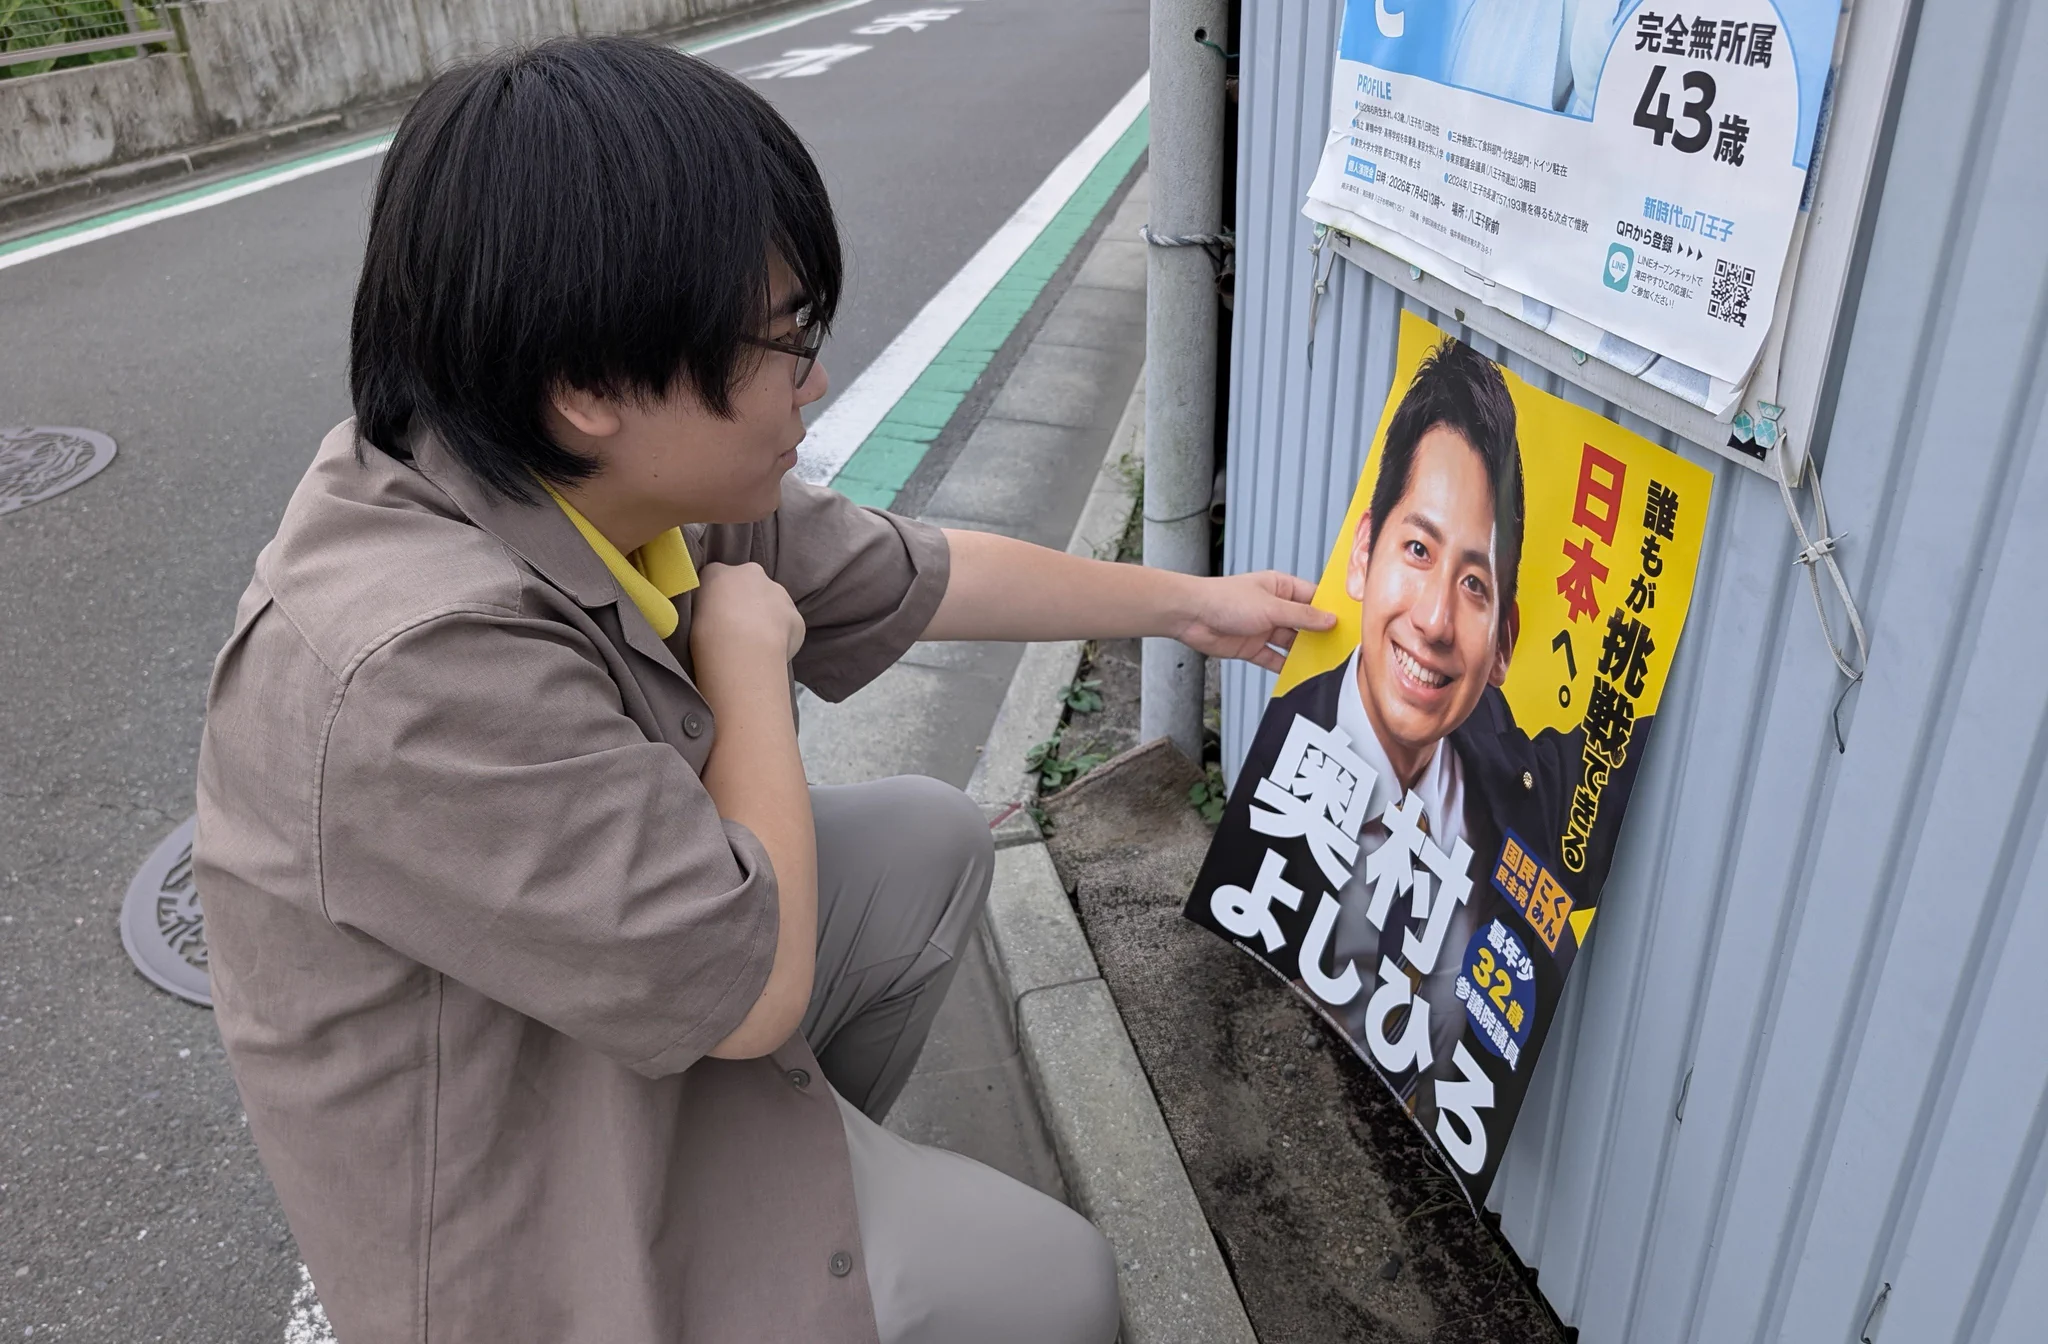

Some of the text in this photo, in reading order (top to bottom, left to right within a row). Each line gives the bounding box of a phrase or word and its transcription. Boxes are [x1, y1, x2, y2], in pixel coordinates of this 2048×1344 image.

[1634, 11, 1777, 69] 完全無所属
[1357, 74, 1392, 100] PROFILE
[1633, 65, 1750, 167] 43歳
[1616, 220, 1674, 253] QRから登録
[1642, 196, 1735, 243] 新時代の八王子
[1611, 259, 1626, 272] LINE
[1634, 269, 1694, 300] 滝田やすひこの応援に
[1637, 254, 1703, 287] LINEオープンチャットで
[1552, 442, 1627, 709] 日本へ。
[1249, 713, 1475, 975] 奥村
[1501, 837, 1539, 889] 国民
[1495, 864, 1529, 908] 民主党
[1538, 877, 1567, 919] こく
[1531, 900, 1557, 943] みん
[1487, 918, 1534, 982] 最年少
[1210, 847, 1494, 1175] よしひろ
[1472, 947, 1525, 1033] 32歳
[1455, 975, 1521, 1072] 参議院議員
